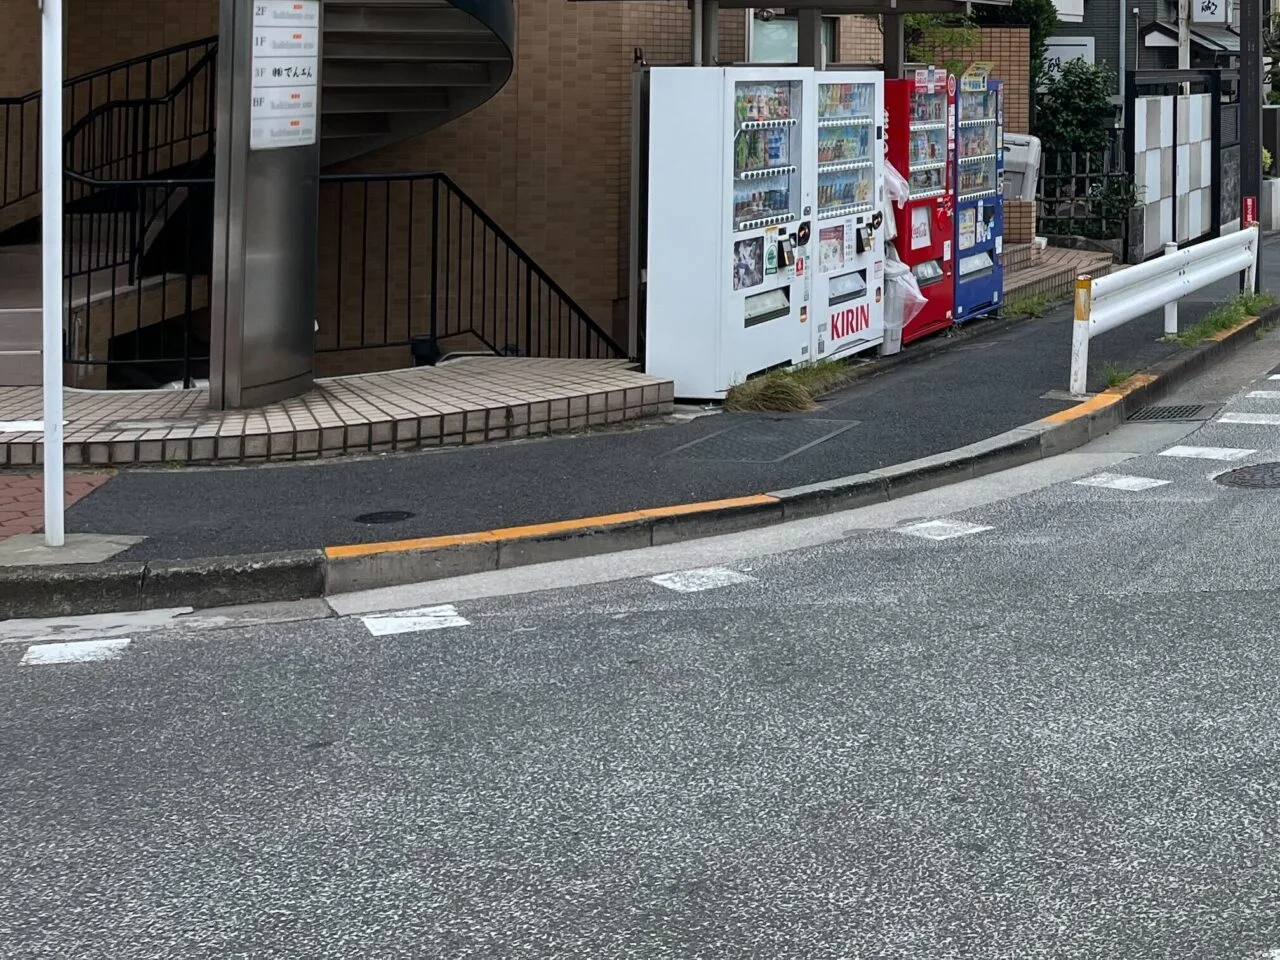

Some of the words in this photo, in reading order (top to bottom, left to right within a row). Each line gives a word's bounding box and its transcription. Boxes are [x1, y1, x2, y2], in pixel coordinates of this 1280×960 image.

[255, 6, 266, 16] 2F
[255, 36, 266, 47] 1F
[830, 303, 870, 340] KIRIN
